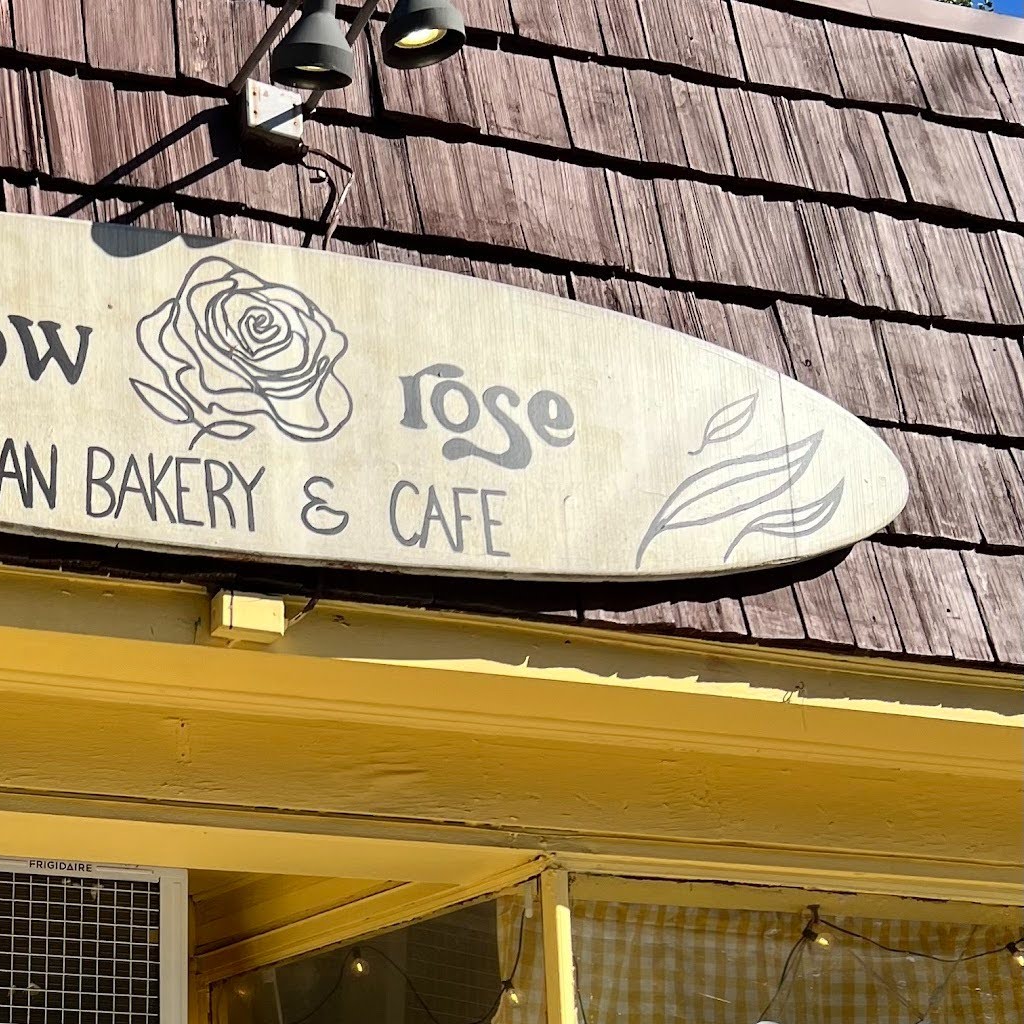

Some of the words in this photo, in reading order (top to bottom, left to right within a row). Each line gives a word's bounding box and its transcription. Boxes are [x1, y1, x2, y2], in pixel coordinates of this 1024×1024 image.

[400, 362, 575, 469] rose
[85, 446, 267, 533] BAKERY
[300, 476, 349, 535] &
[390, 481, 511, 557] CAFE
[29, 860, 93, 873] FRIGIDAIRE
